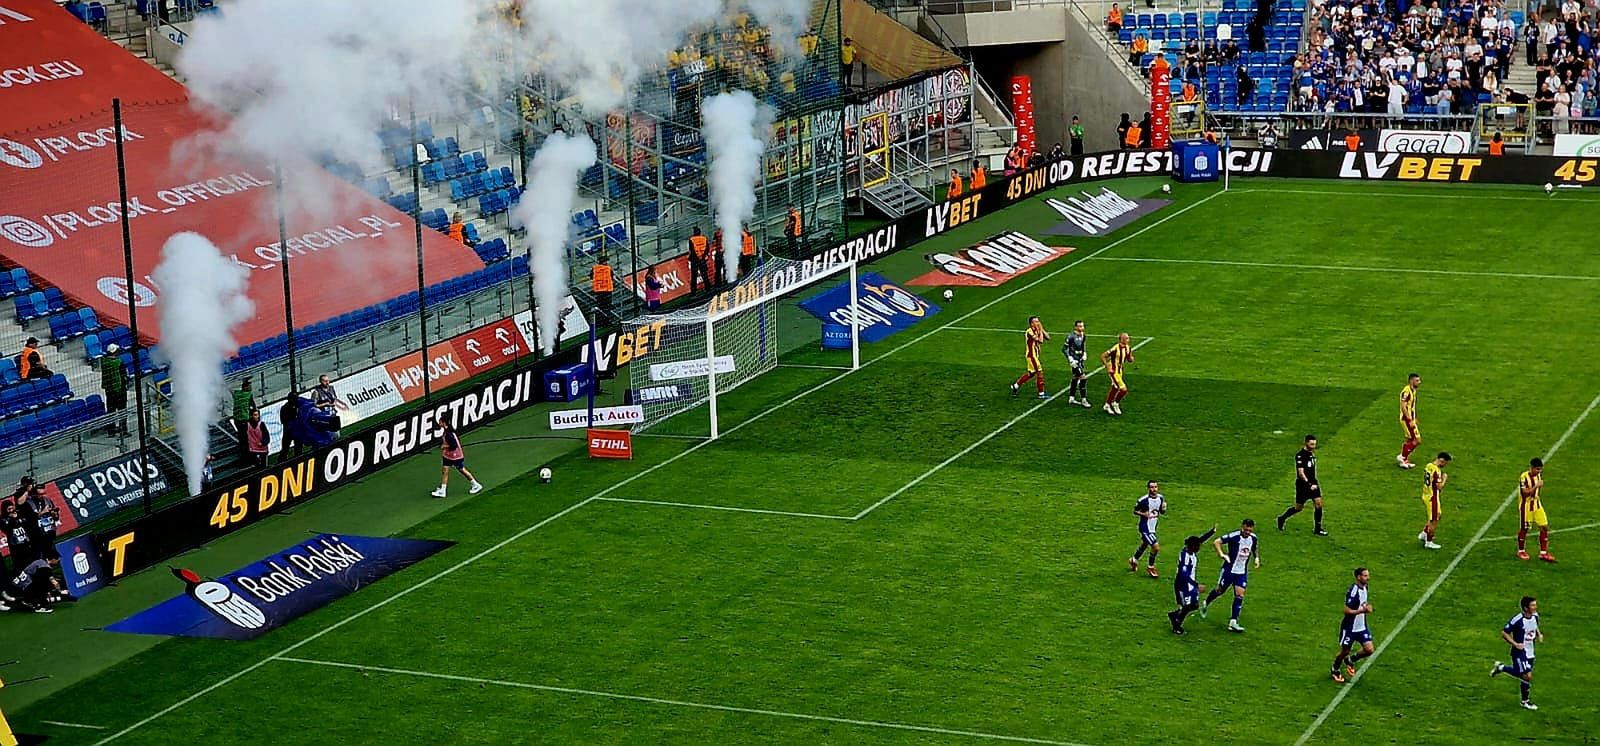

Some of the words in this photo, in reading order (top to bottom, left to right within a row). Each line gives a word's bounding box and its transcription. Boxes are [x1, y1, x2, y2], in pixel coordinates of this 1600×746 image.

[1007, 176, 1022, 201] 45
[1024, 167, 1048, 195] DNI
[1050, 160, 1074, 184] OD
[1081, 151, 1273, 181] REJESTCJI
[1554, 159, 1598, 182] 45
[607, 409, 639, 421] Auto
[210, 484, 249, 529] 45
[258, 457, 316, 513] DNI
[324, 440, 365, 483] OD
[373, 370, 532, 465] REJESTRACJI
[590, 438, 629, 450] STIHL
[108, 531, 135, 577] T
[237, 561, 312, 603] Bank
[289, 536, 365, 580] Polski
